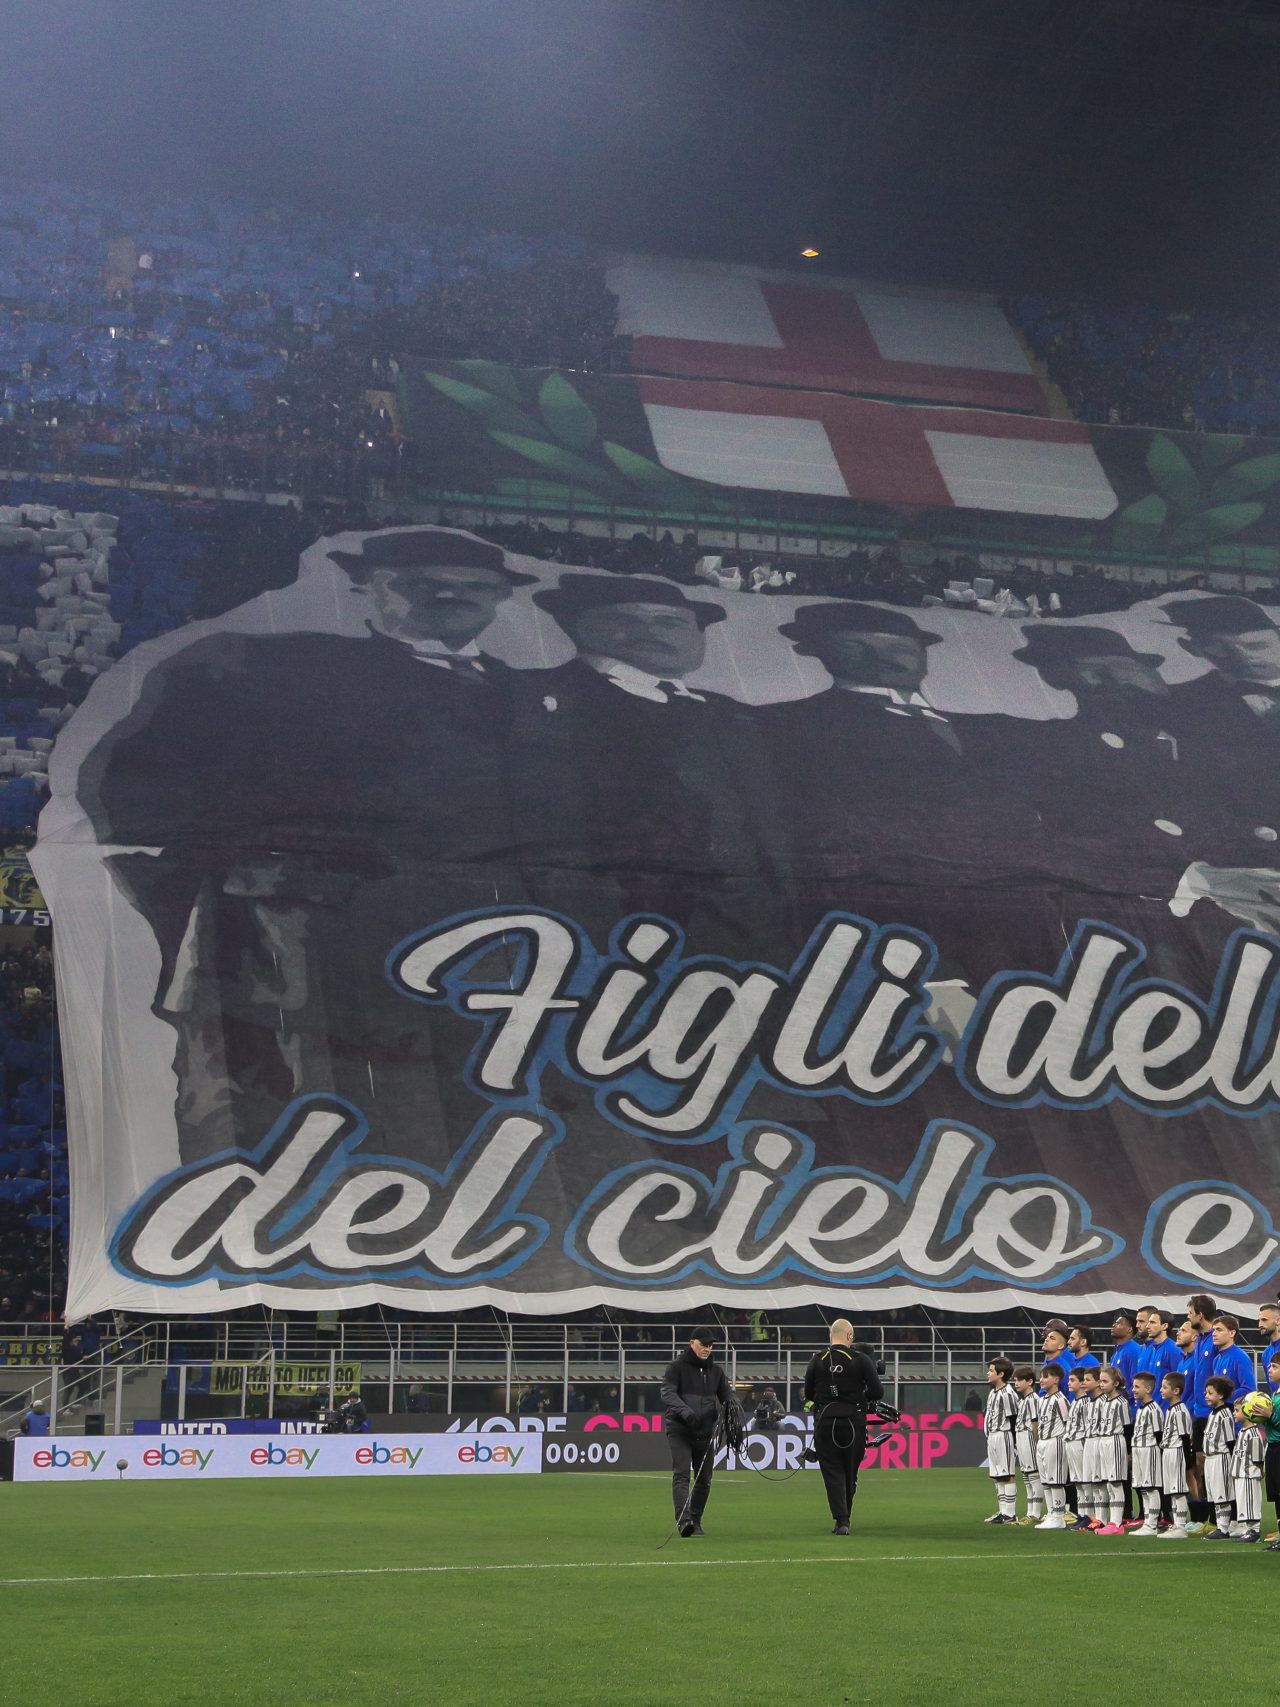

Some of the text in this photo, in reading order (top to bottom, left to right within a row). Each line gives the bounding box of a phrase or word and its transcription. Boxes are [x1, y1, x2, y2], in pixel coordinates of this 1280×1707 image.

[398, 912, 929, 1133] Figli
[130, 1109, 527, 1277] del
[586, 1129, 1102, 1279] cielo
[1160, 1191, 1279, 1286] e
[33, 1440, 525, 1472] ebay ebay ebay ebay ebay
[546, 1442, 620, 1464] 00:00
